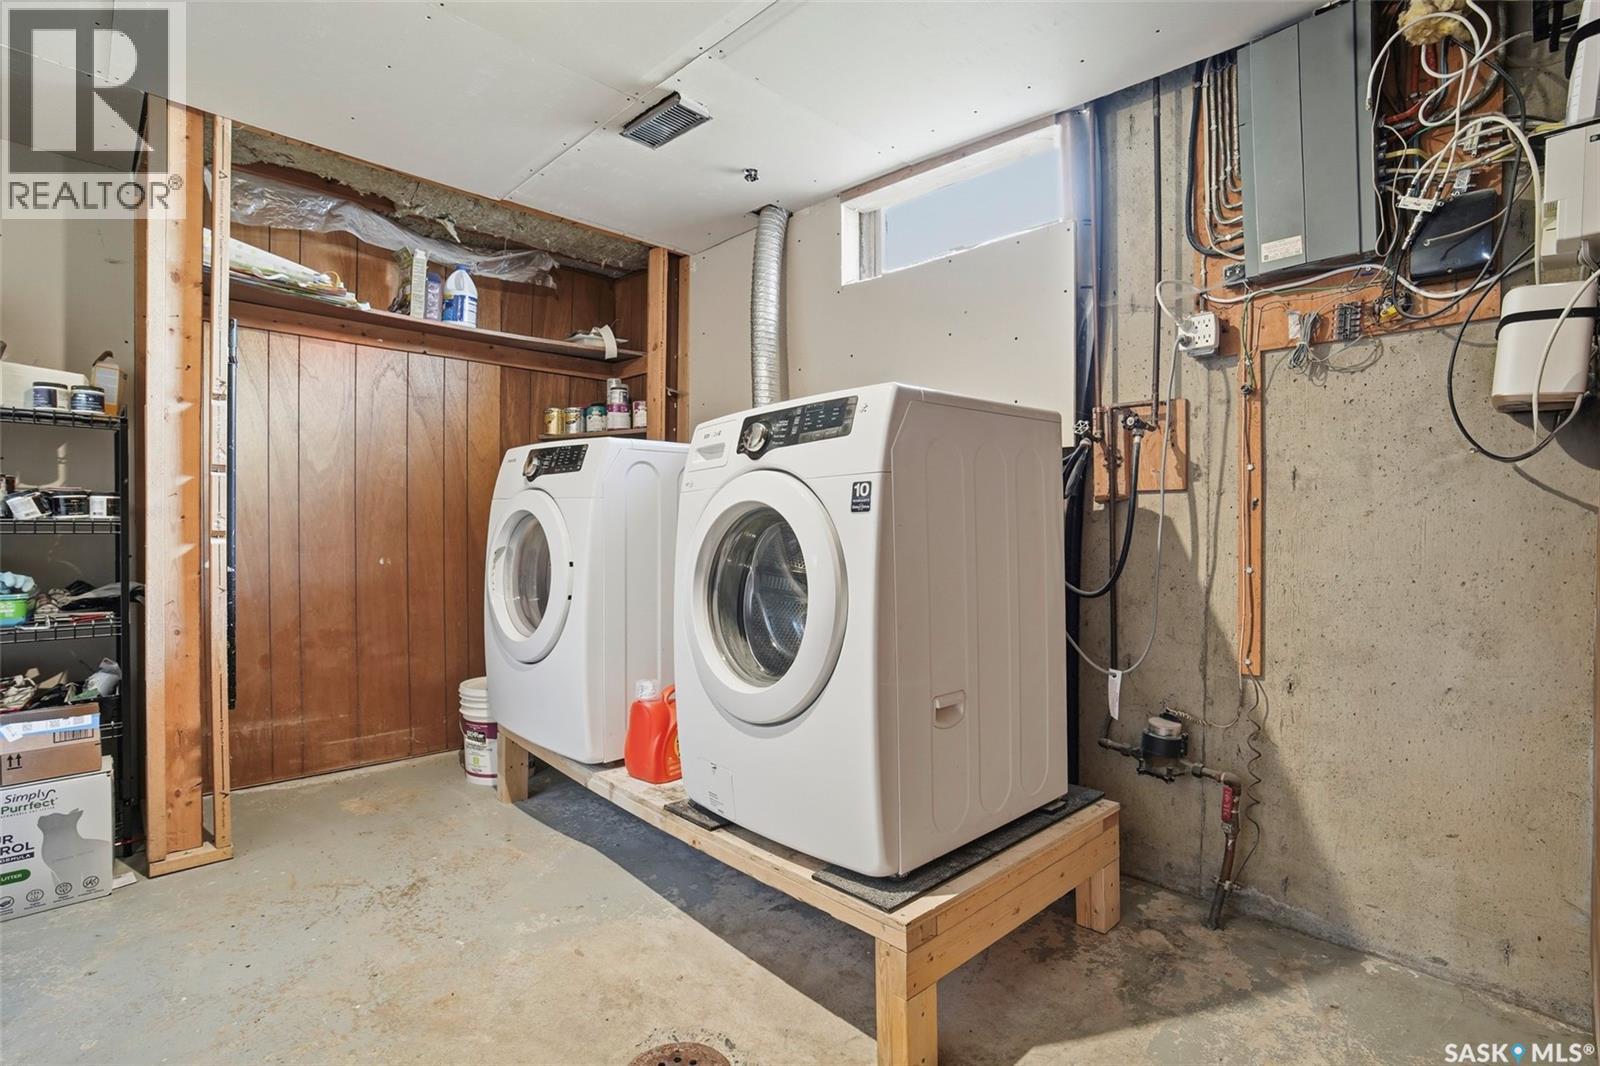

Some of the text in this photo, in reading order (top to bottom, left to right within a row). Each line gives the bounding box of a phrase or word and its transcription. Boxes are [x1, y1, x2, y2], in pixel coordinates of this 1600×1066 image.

[854, 482, 870, 497] 10
[4, 789, 56, 804] Simply
[1, 798, 55, 815] Purrfect
